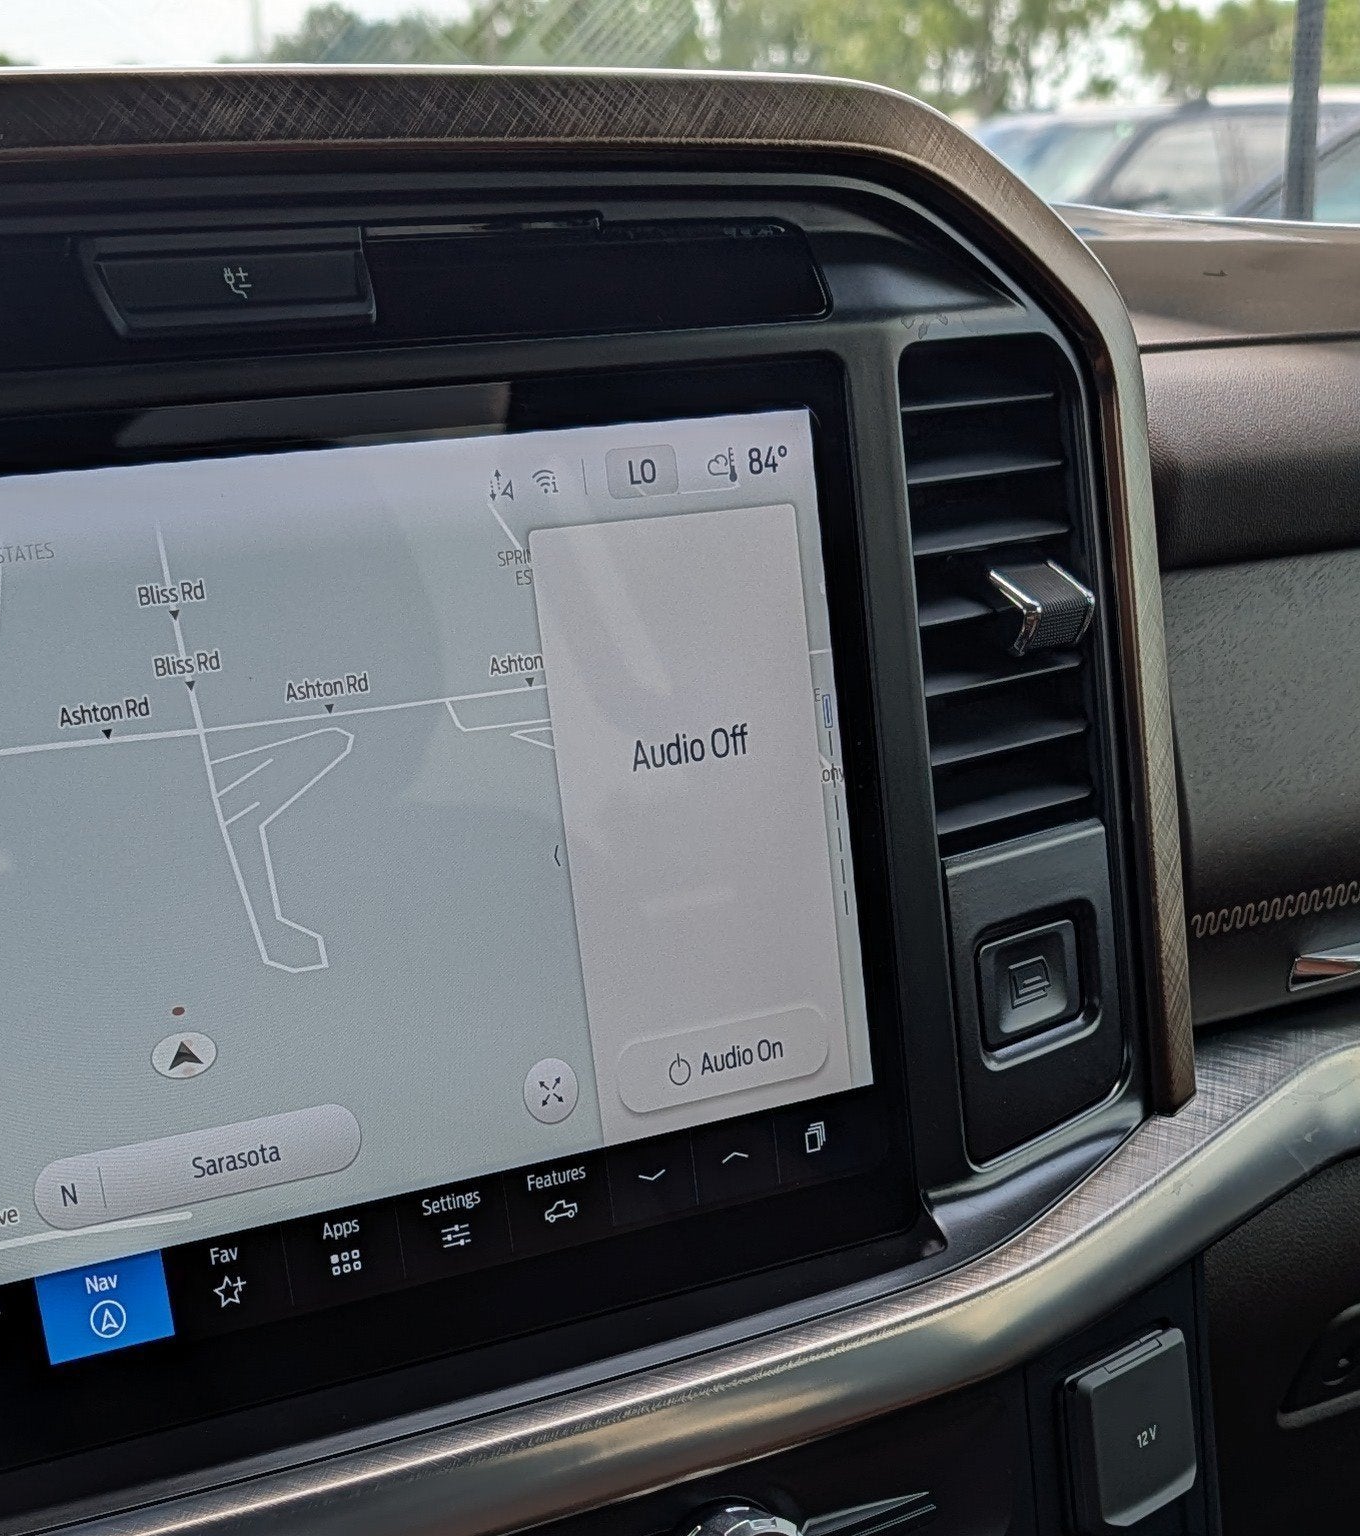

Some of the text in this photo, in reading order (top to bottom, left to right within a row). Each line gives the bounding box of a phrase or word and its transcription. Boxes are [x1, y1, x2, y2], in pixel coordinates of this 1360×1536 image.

[628, 459, 656, 485] LO
[748, 445, 788, 475] 84°
[137, 579, 205, 607] Bliss Rd
[154, 650, 220, 678] Bliss Rd
[490, 653, 543, 675] Ashton
[285, 673, 369, 702] Ashton Rd
[58, 697, 149, 728] Ashton Rd
[632, 724, 748, 772] Audio Off
[700, 1039, 783, 1077] Audio On
[192, 1143, 281, 1178] Sarasota
[526, 1165, 585, 1191] Features
[60, 1184, 79, 1205] N
[422, 1189, 481, 1217] Settings
[322, 1219, 360, 1241] Apps
[210, 1246, 239, 1268] Fav
[85, 1272, 117, 1294] Nav
